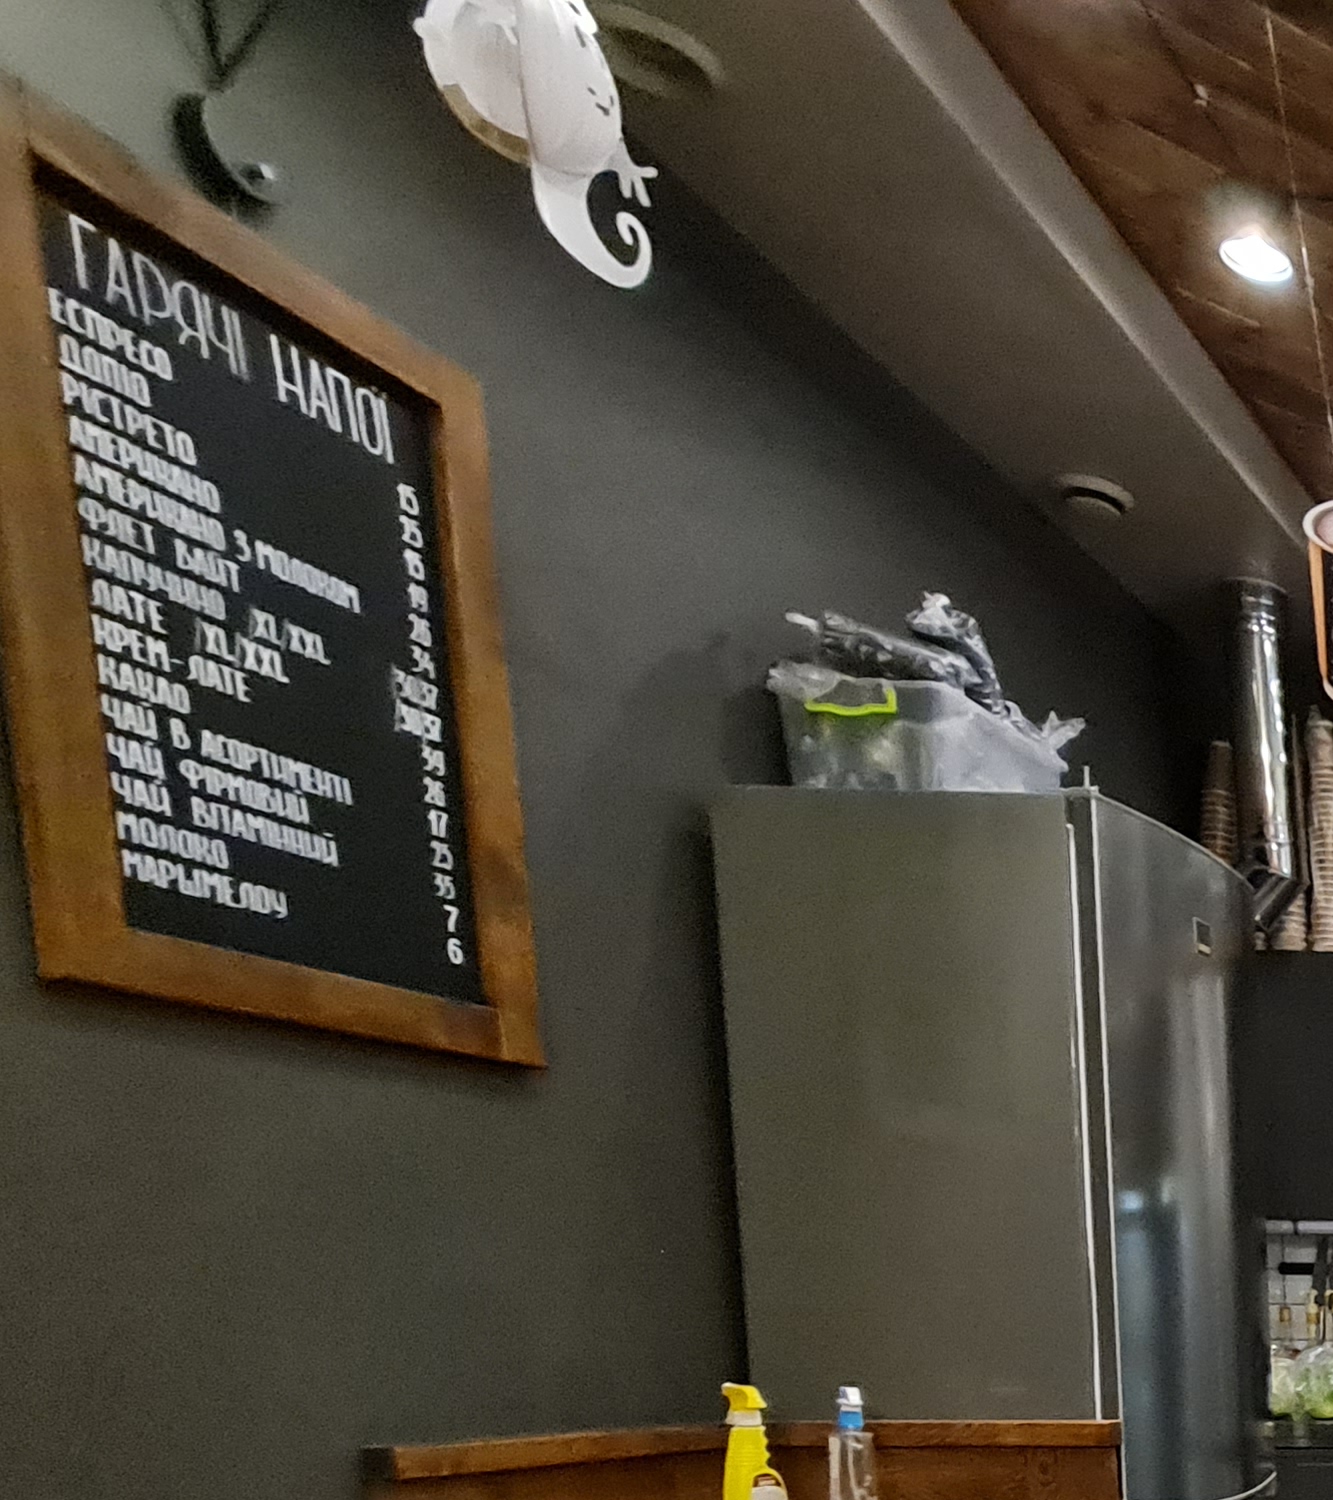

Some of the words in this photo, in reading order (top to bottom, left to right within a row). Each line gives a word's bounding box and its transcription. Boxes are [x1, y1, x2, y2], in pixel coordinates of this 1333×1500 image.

[48, 287, 173, 381] ЕСПРЕСО
[68, 213, 249, 380] ГАРЯЧІ
[269, 333, 395, 464] НАПОЇ
[78, 497, 155, 554] ФЛЕТ
[91, 578, 168, 634] ЛАТЕ
[97, 653, 191, 714] КАКАО
[101, 693, 158, 740] ЧАЙ
[169, 718, 191, 750] В
[105, 732, 166, 780] ЧАЙ
[110, 771, 172, 817] ЧАЙ
[115, 810, 230, 870] МОЛОКО
[443, 904, 459, 932] 7
[447, 937, 464, 965] 6
